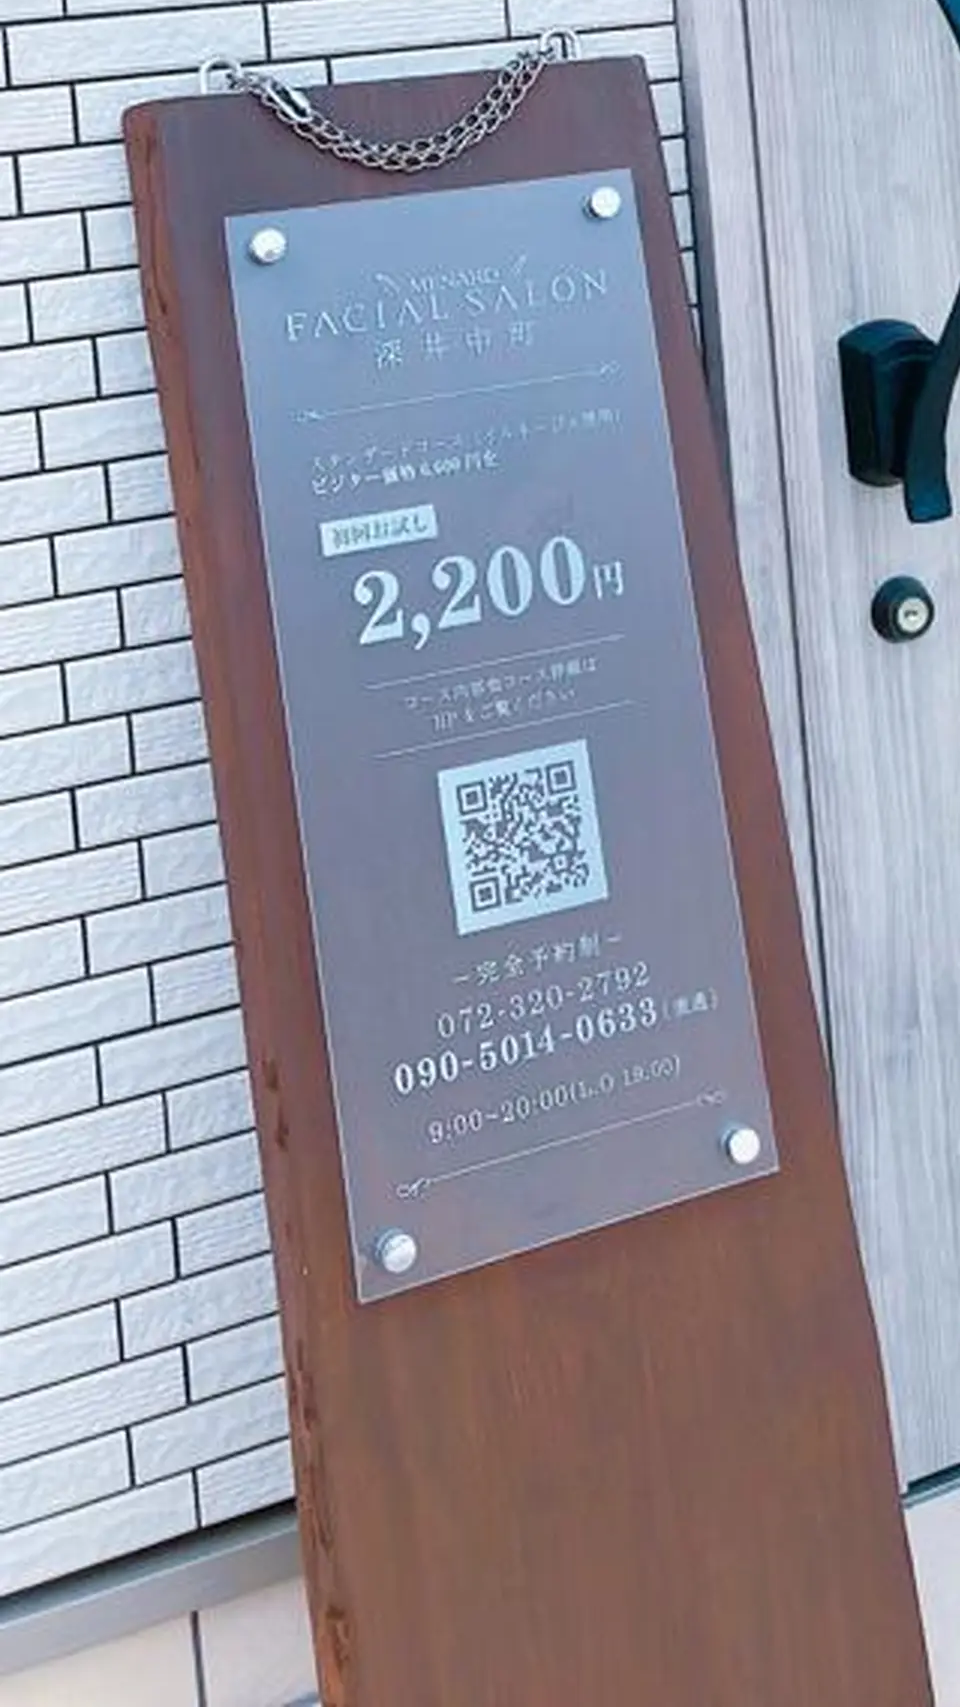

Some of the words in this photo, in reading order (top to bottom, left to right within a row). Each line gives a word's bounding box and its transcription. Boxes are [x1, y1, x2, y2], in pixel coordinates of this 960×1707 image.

[284, 294, 450, 344] FACIAL
[462, 268, 609, 319] SALON
[373, 320, 535, 372] 深井中町
[330, 516, 430, 552] 初回お試し
[436, 961, 652, 1039] 072-320-2792
